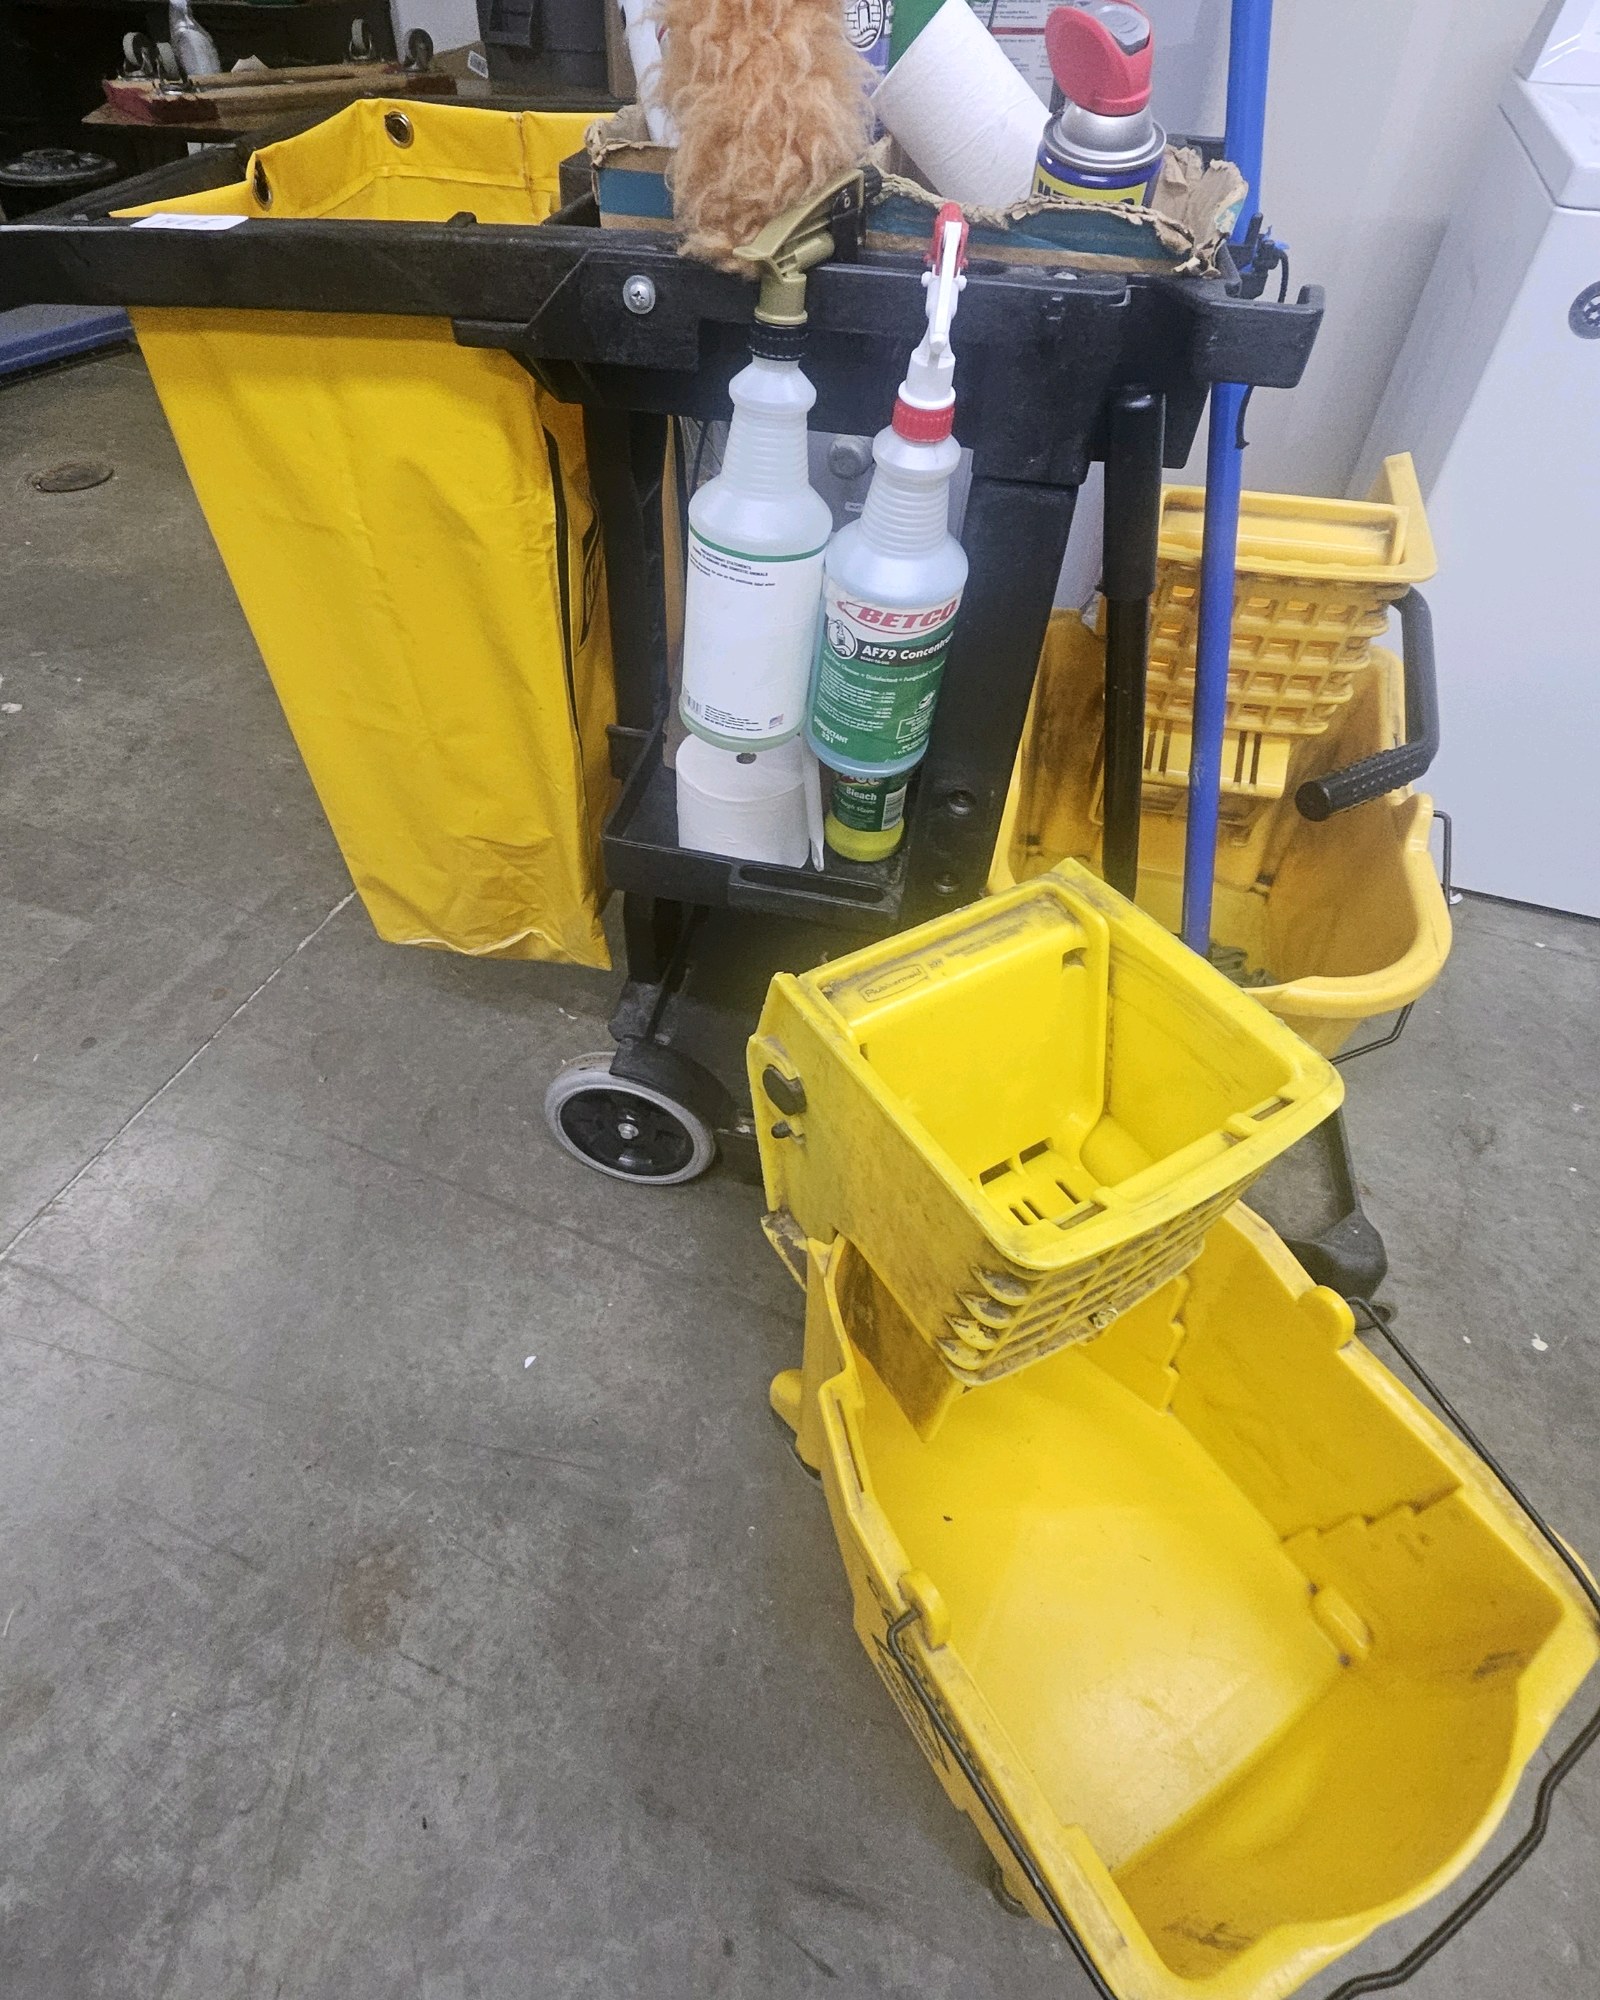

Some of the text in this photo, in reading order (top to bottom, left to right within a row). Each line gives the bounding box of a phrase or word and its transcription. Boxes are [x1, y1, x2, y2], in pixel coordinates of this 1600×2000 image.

[857, 598, 958, 629] BETCO
[861, 645, 898, 661] AF79
[845, 786, 878, 801] Bleach
